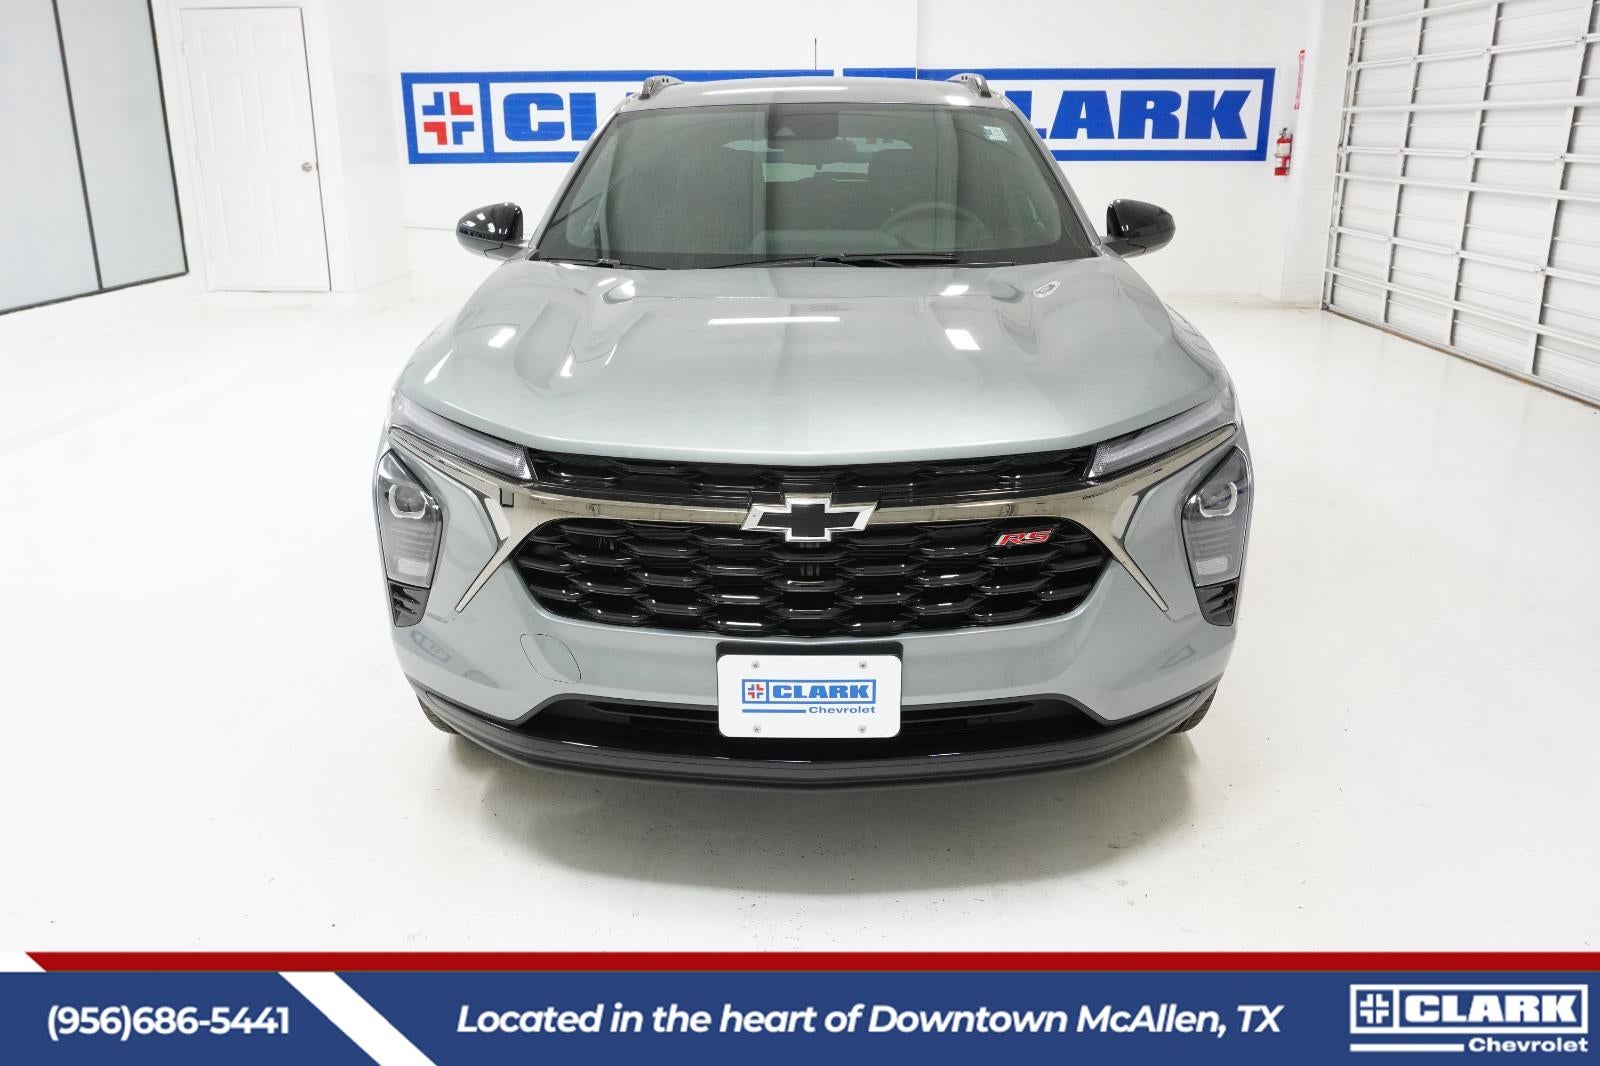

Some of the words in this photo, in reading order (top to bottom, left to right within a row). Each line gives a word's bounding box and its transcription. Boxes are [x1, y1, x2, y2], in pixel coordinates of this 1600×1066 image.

[994, 528, 1053, 546] RS
[772, 684, 870, 700] CLARK
[808, 705, 877, 714] Chevrolet
